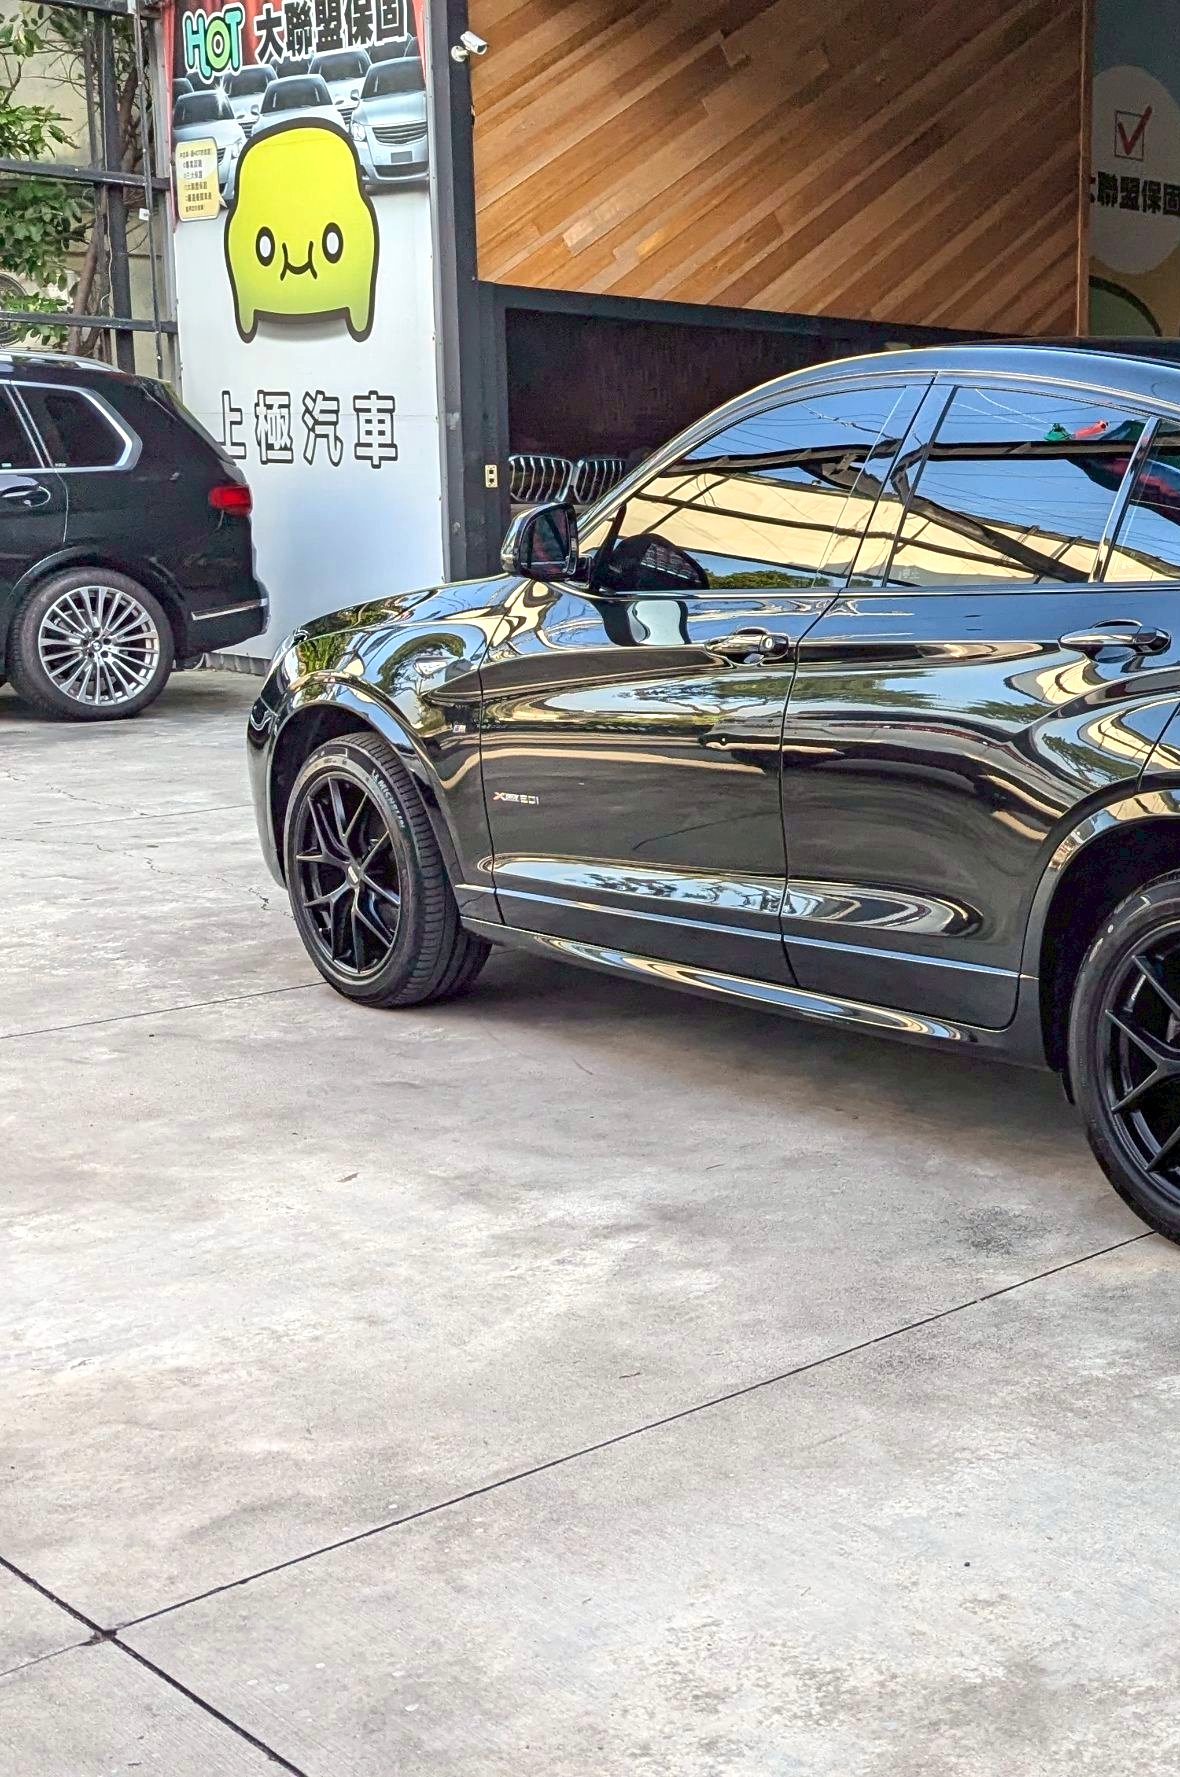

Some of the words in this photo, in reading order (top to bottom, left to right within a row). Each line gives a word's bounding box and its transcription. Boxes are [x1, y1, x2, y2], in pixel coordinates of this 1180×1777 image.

[185, 7, 244, 80] HOT
[256, 0, 405, 64] 大聯盟保固
[216, 389, 399, 469] 上極汽車
